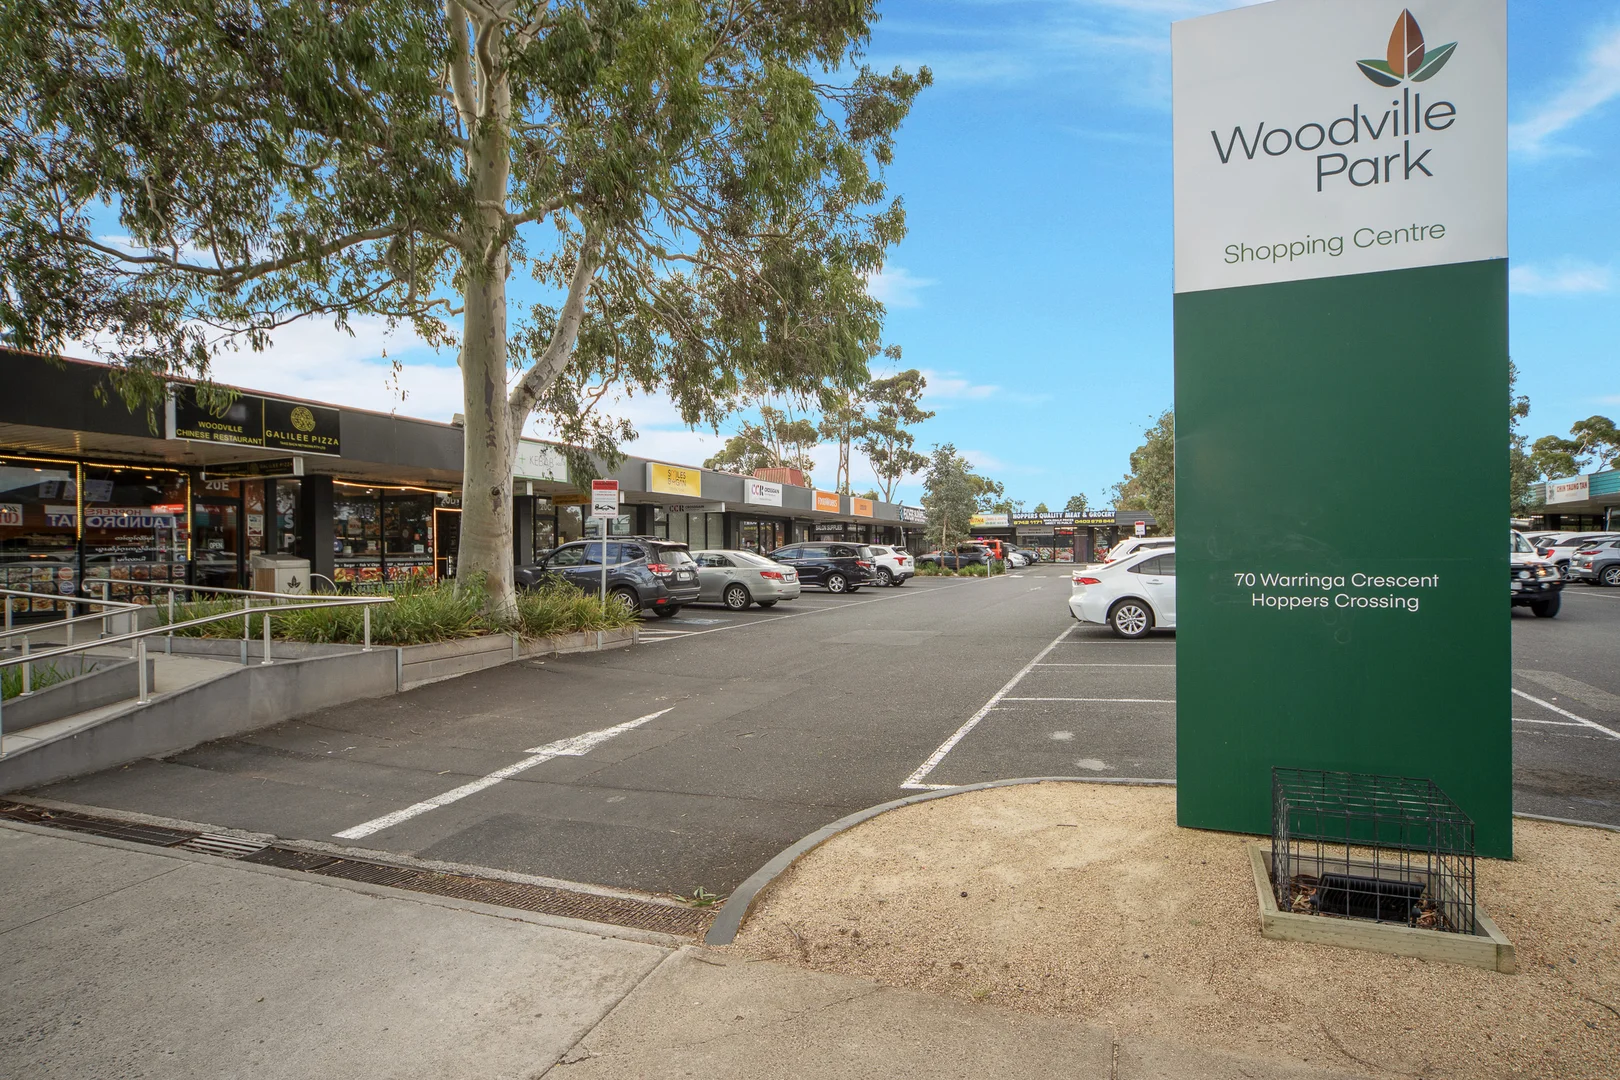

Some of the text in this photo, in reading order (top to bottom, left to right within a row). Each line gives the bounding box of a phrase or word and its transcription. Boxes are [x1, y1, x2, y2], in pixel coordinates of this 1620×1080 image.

[1211, 88, 1457, 164] Woodville
[1317, 140, 1433, 192] Park
[1224, 223, 1446, 264] Shopping Centre
[198, 421, 243, 433] WOODVILLE
[176, 428, 263, 445] CHINESE RESTAURANT
[266, 429, 339, 446] GALILEE PIZZA
[529, 455, 554, 469] KEBAB
[668, 469, 686, 480] SMILES
[205, 481, 230, 491] 20E
[752, 484, 764, 496] CCR
[669, 504, 685, 512] CCR
[1234, 573, 1439, 590] 70 Warringa Crescent
[1252, 593, 1419, 612] Hoppers Crossing
